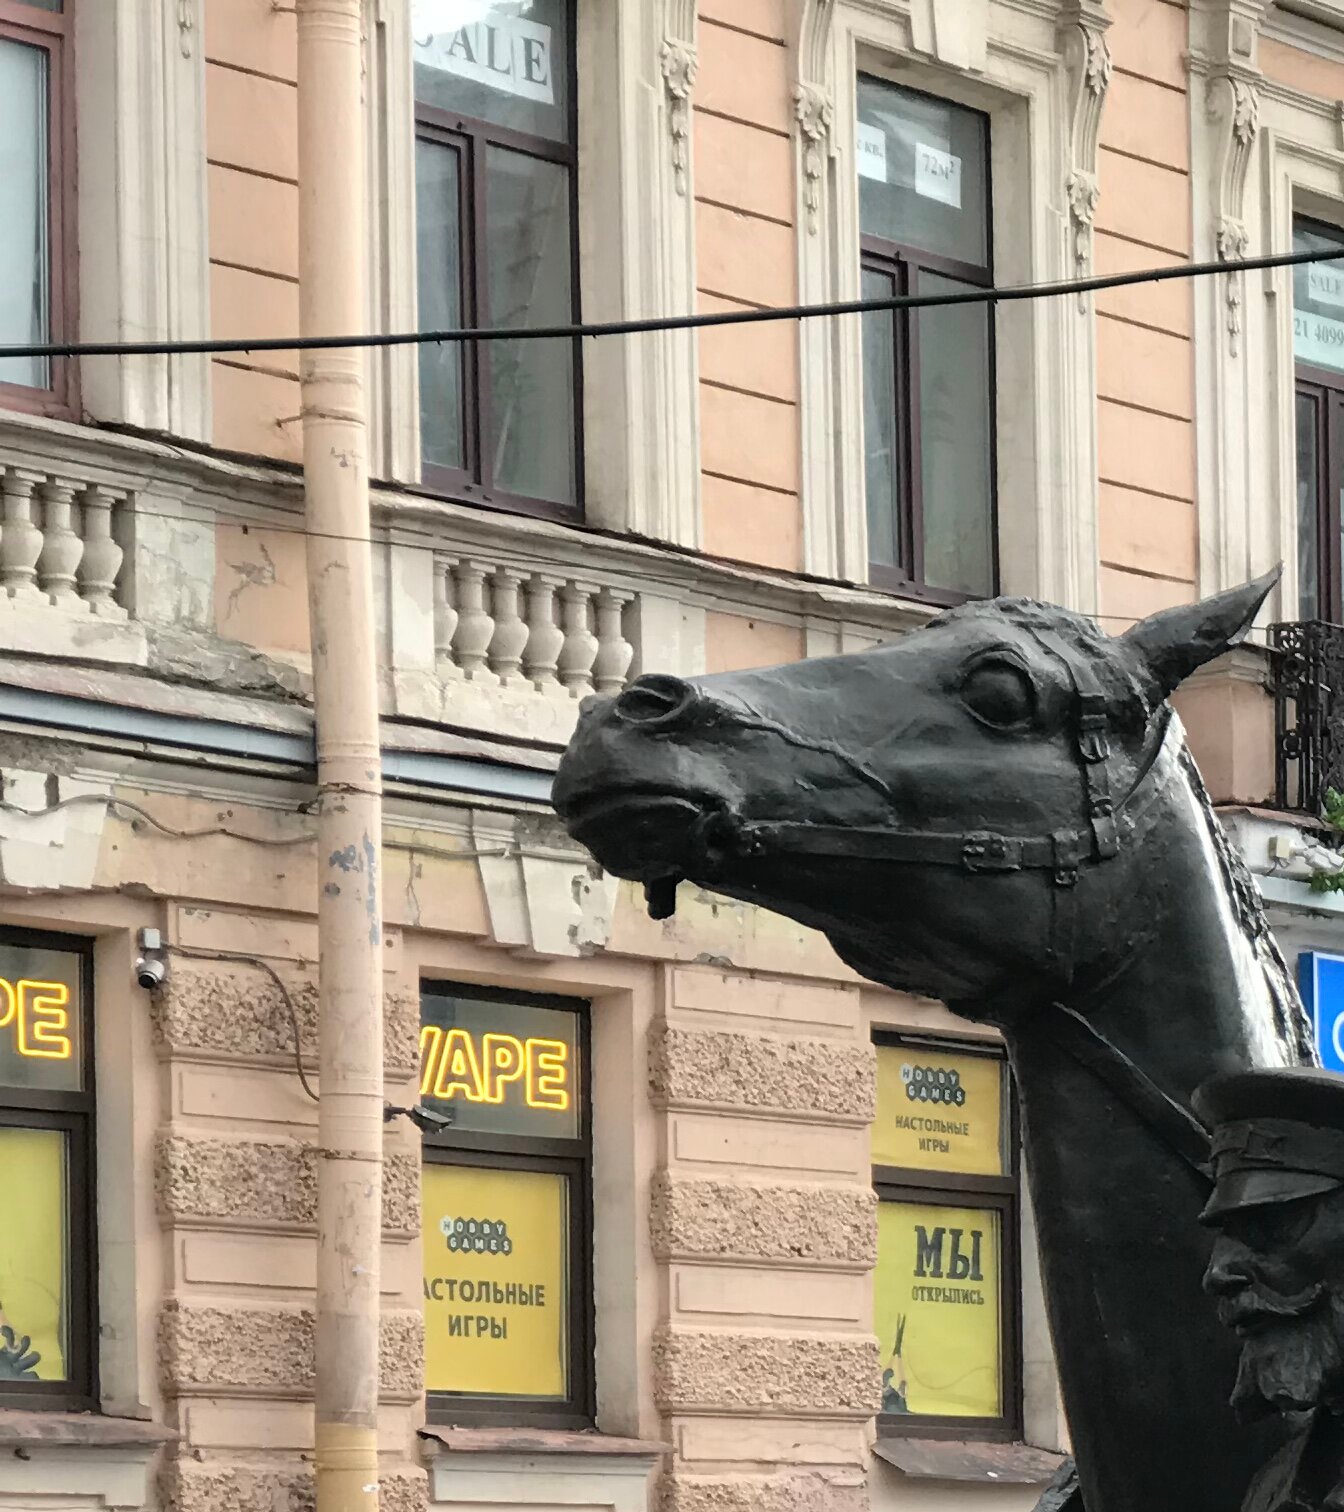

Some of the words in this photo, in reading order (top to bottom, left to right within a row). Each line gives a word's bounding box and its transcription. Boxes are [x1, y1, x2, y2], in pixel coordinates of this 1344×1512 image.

[903, 1067, 957, 1085] HOBBY
[909, 1085, 963, 1102] GAMES
[896, 1115, 969, 1137] НАСТОЛЬНЫЕ
[919, 1138, 950, 1154] ИГРЫ
[442, 1219, 504, 1236] HOBBY
[450, 1237, 510, 1252] GAMES
[914, 1225, 984, 1282] МЫ
[912, 1285, 984, 1305] ОТКРЫЛИСЬ
[448, 1314, 507, 1339] ИГРЫ
